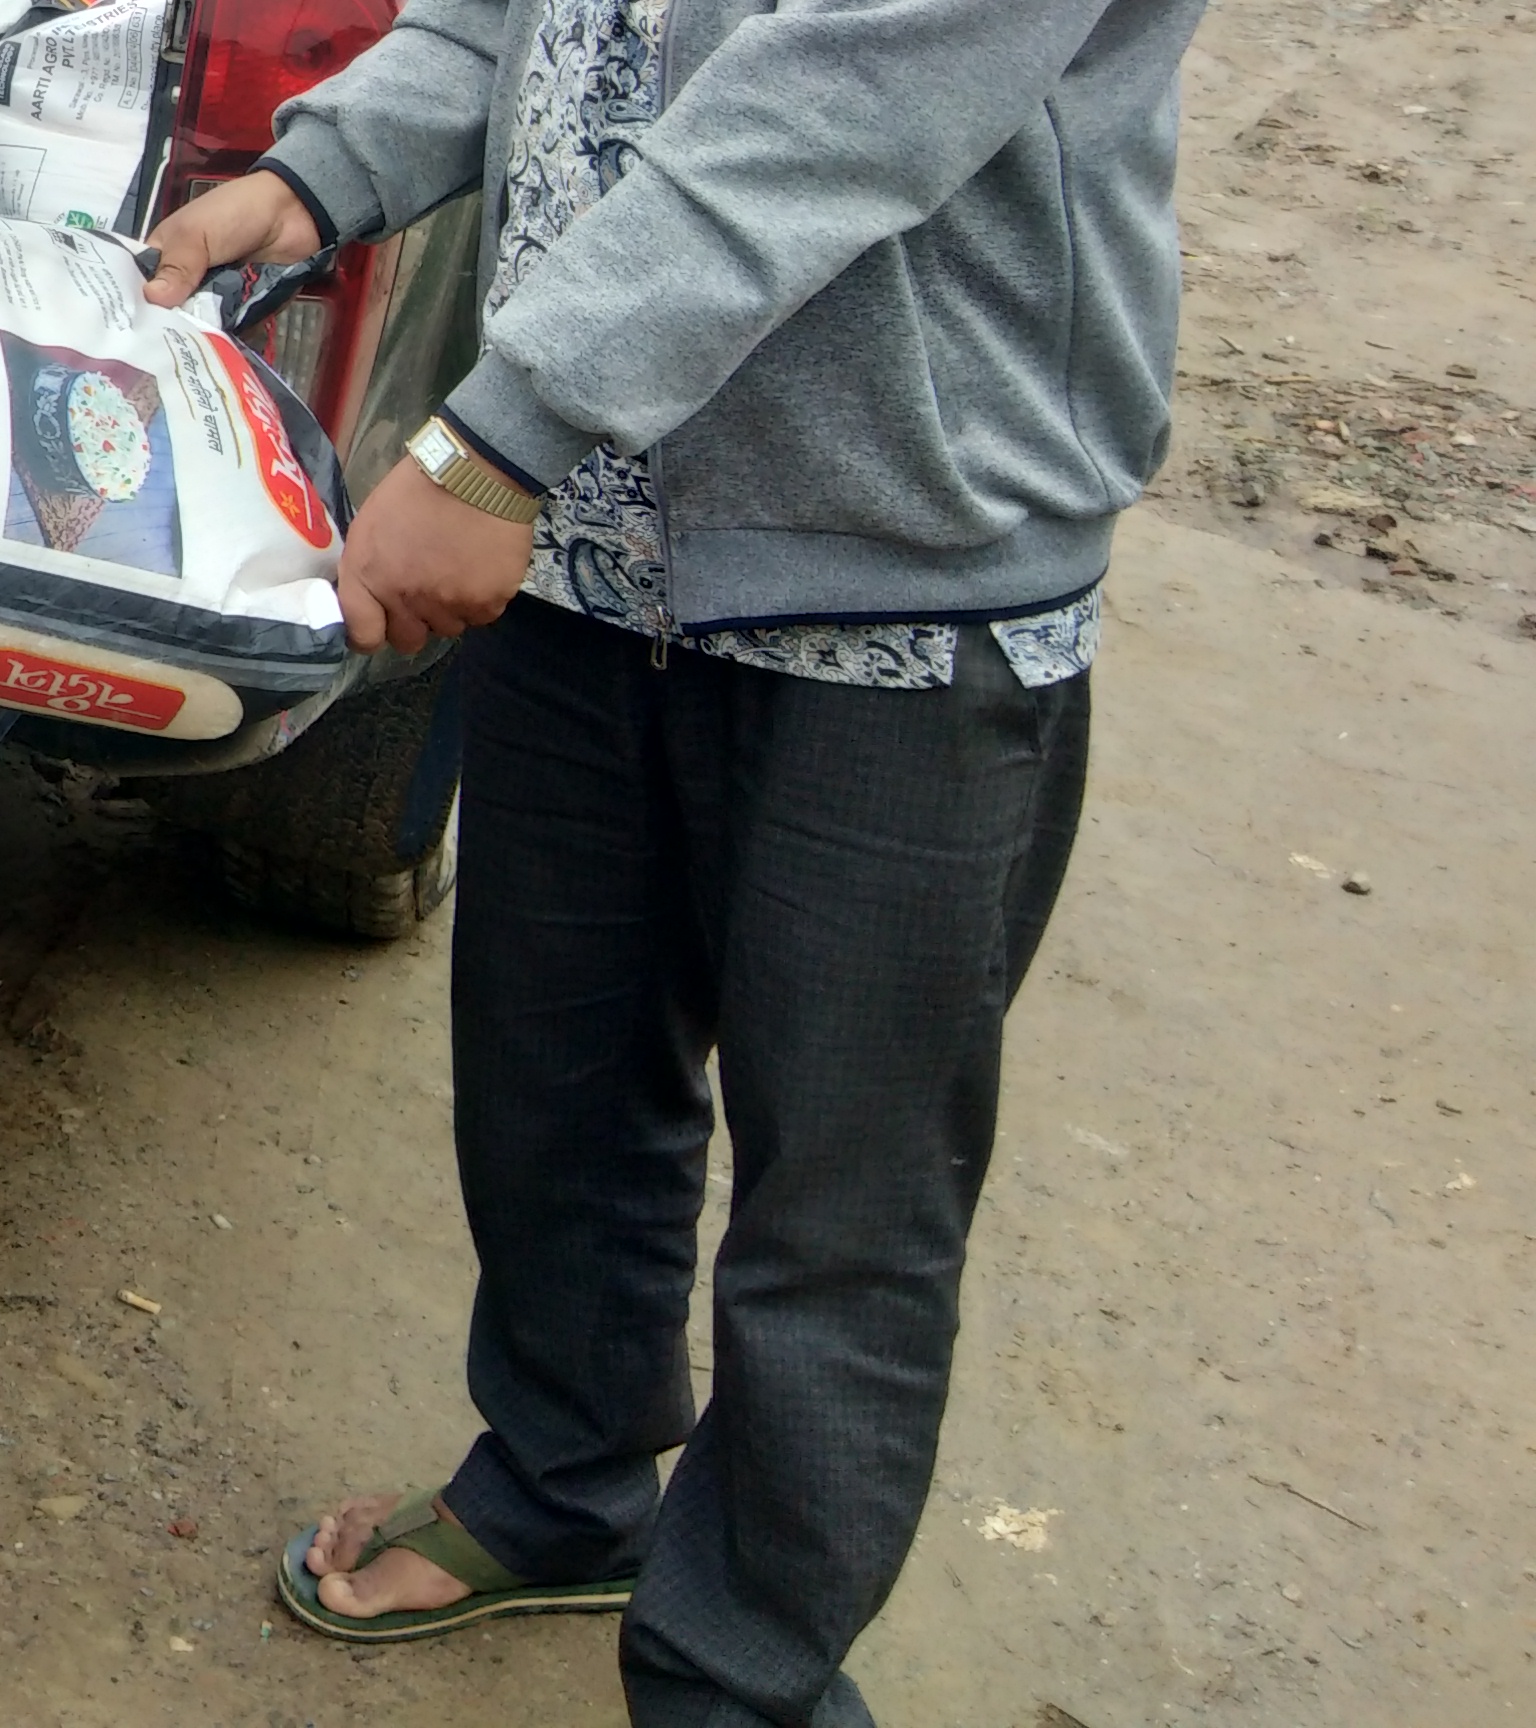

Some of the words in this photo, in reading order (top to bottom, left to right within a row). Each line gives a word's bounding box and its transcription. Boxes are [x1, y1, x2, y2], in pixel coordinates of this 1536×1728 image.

[31, 77, 51, 121] AARTI
[41, 37, 58, 76] AGRO
[203, 415, 224, 456] चामल
